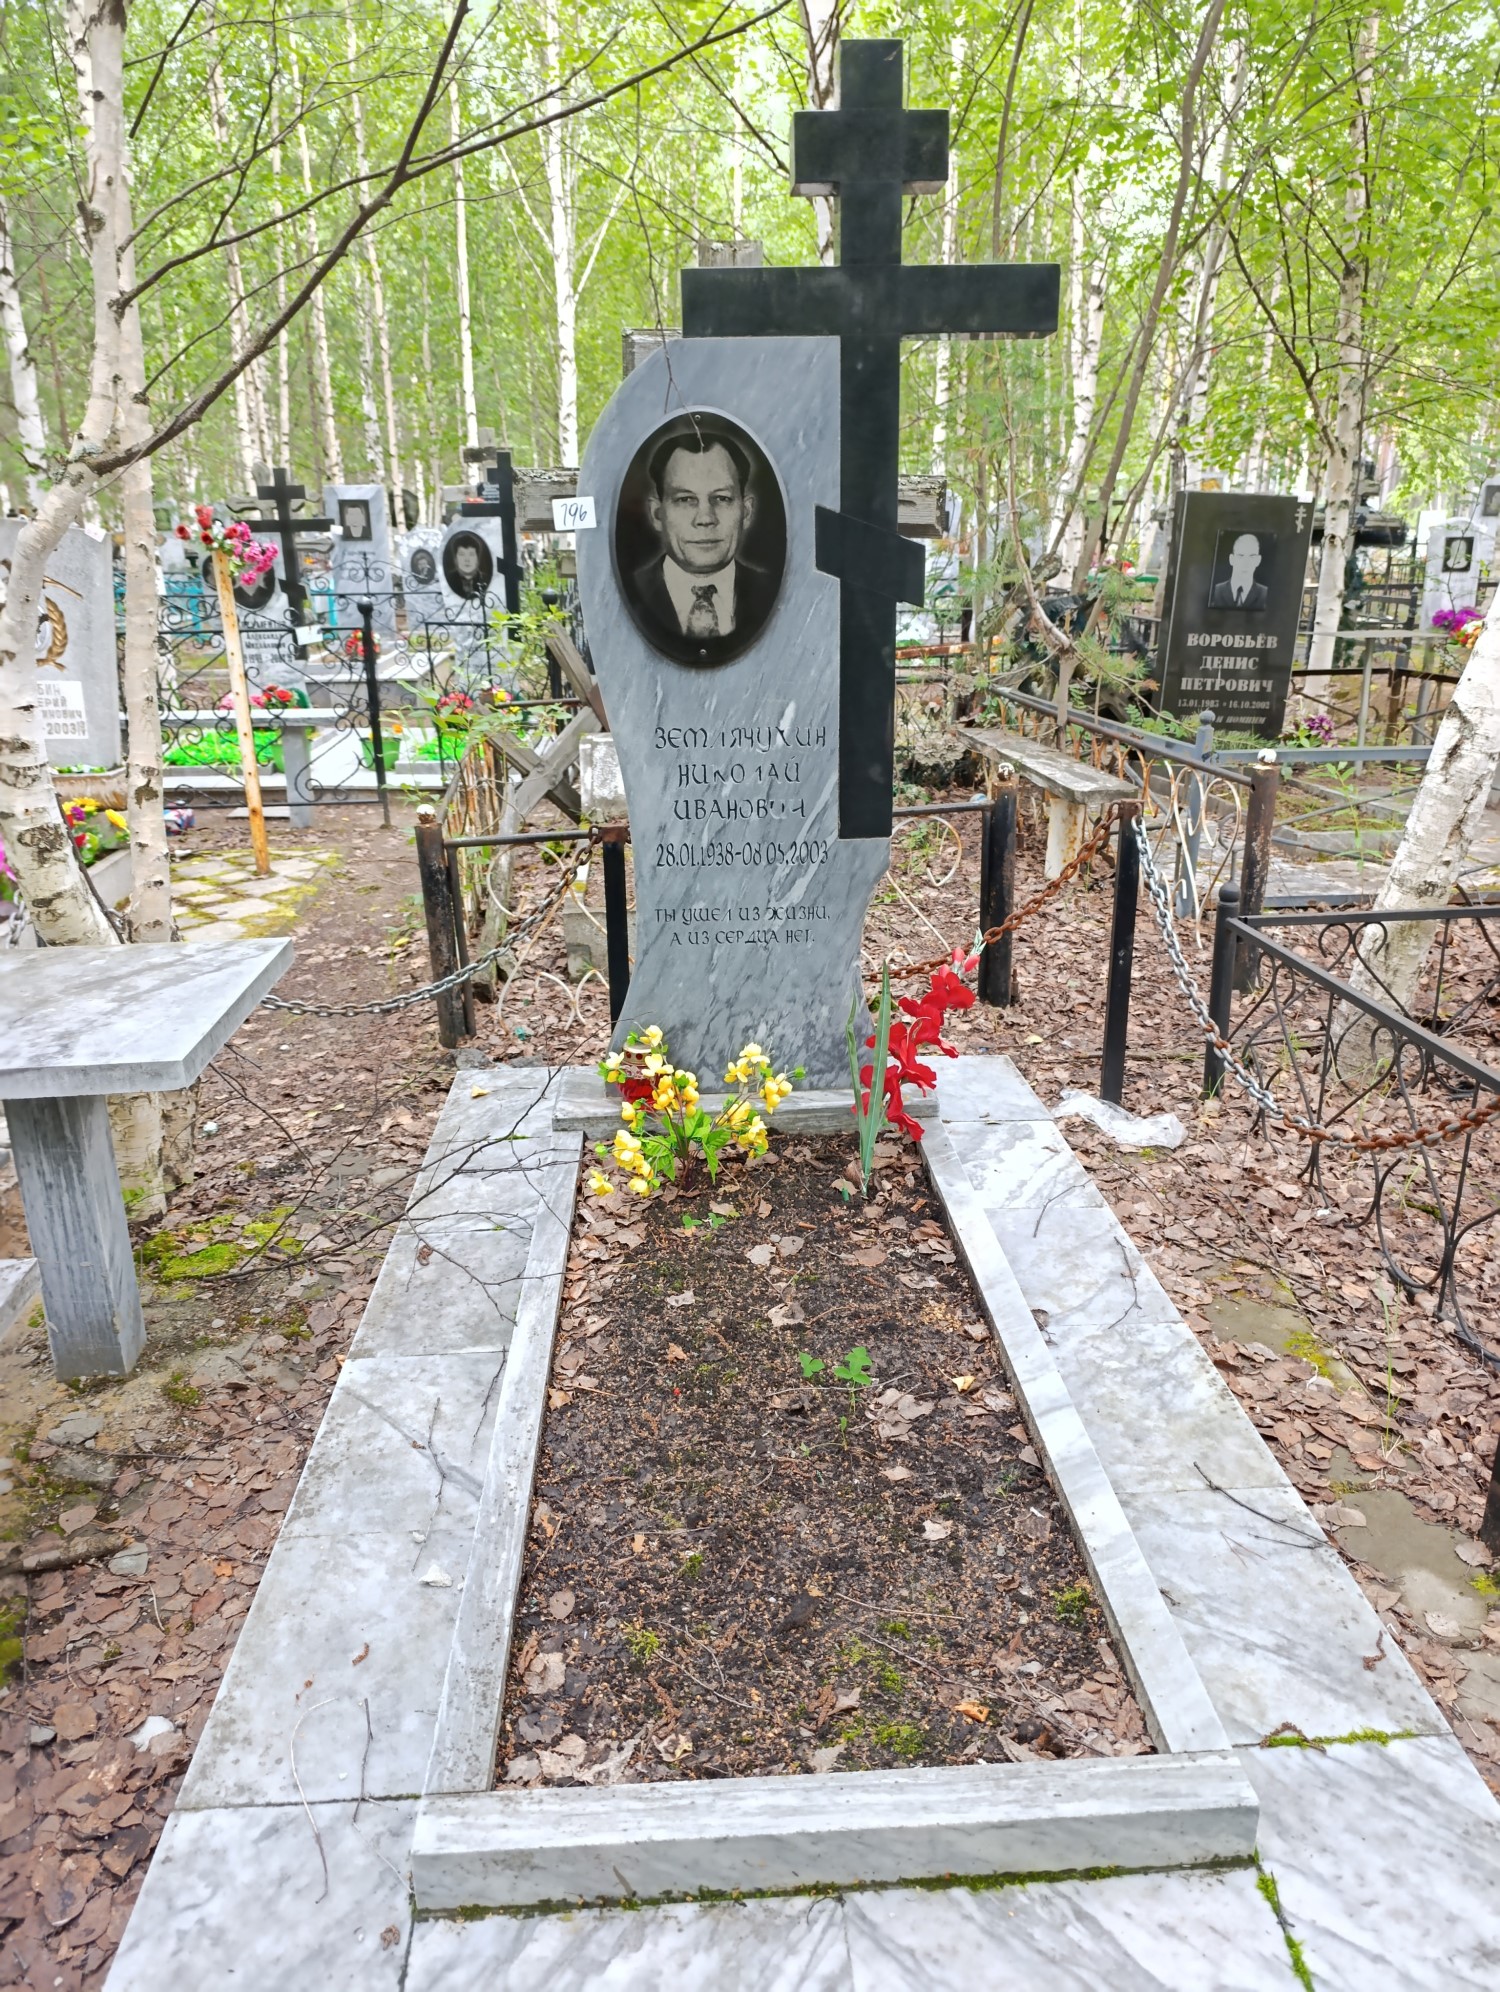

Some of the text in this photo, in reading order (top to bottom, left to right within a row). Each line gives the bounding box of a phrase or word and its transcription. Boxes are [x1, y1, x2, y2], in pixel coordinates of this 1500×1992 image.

[1186, 632, 1279, 649] ВОРОБЬЁВ
[1199, 655, 1260, 671] ДЕНИС
[1180, 677, 1274, 693] ПЕТРОВИЧ
[655, 840, 829, 868] 28.01.1938-0805.2003
[654, 908, 677, 923] ТЫ
[738, 906, 761, 921] ИЗ
[669, 932, 683, 947] А
[687, 931, 711, 945] ИЗ
[714, 929, 780, 945] СЕРДЦА
